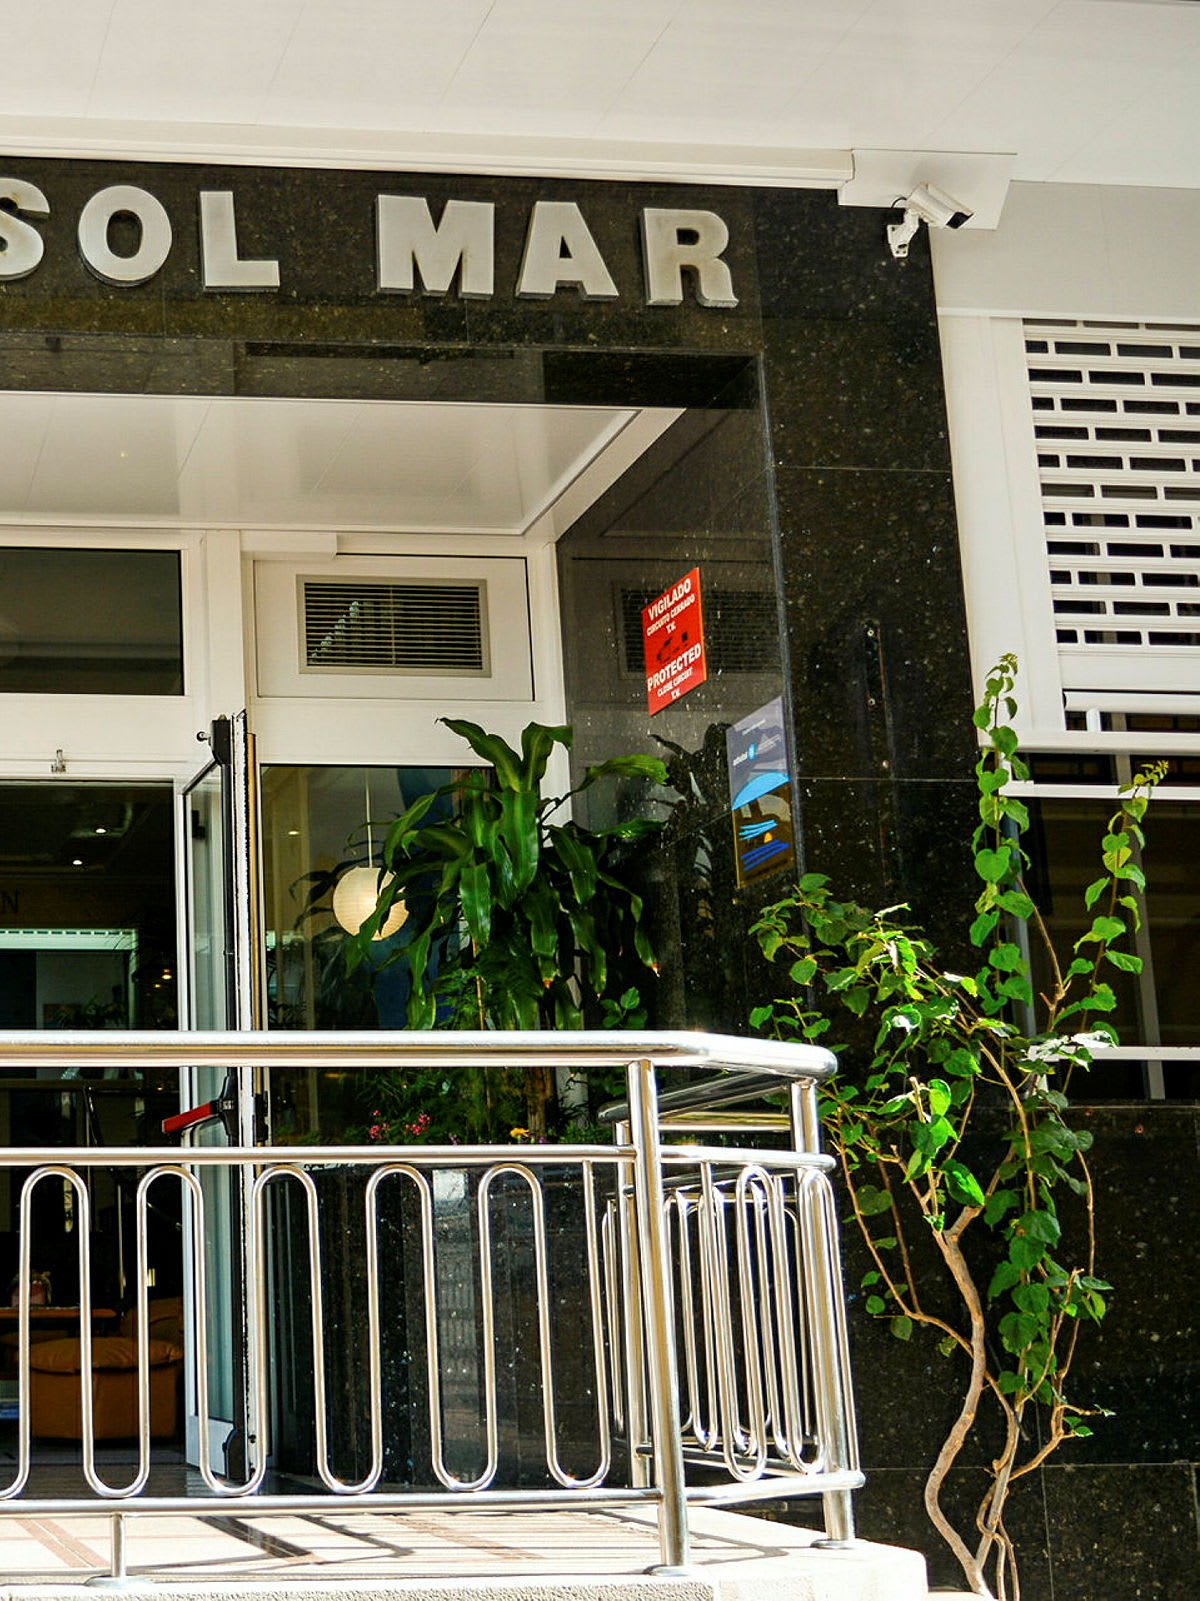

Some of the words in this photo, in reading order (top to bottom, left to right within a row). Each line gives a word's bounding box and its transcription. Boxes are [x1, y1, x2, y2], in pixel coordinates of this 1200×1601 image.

[377, 193, 738, 307] MAR
[648, 578, 692, 620] VIGILADO
[647, 643, 702, 692] PROTECTED
